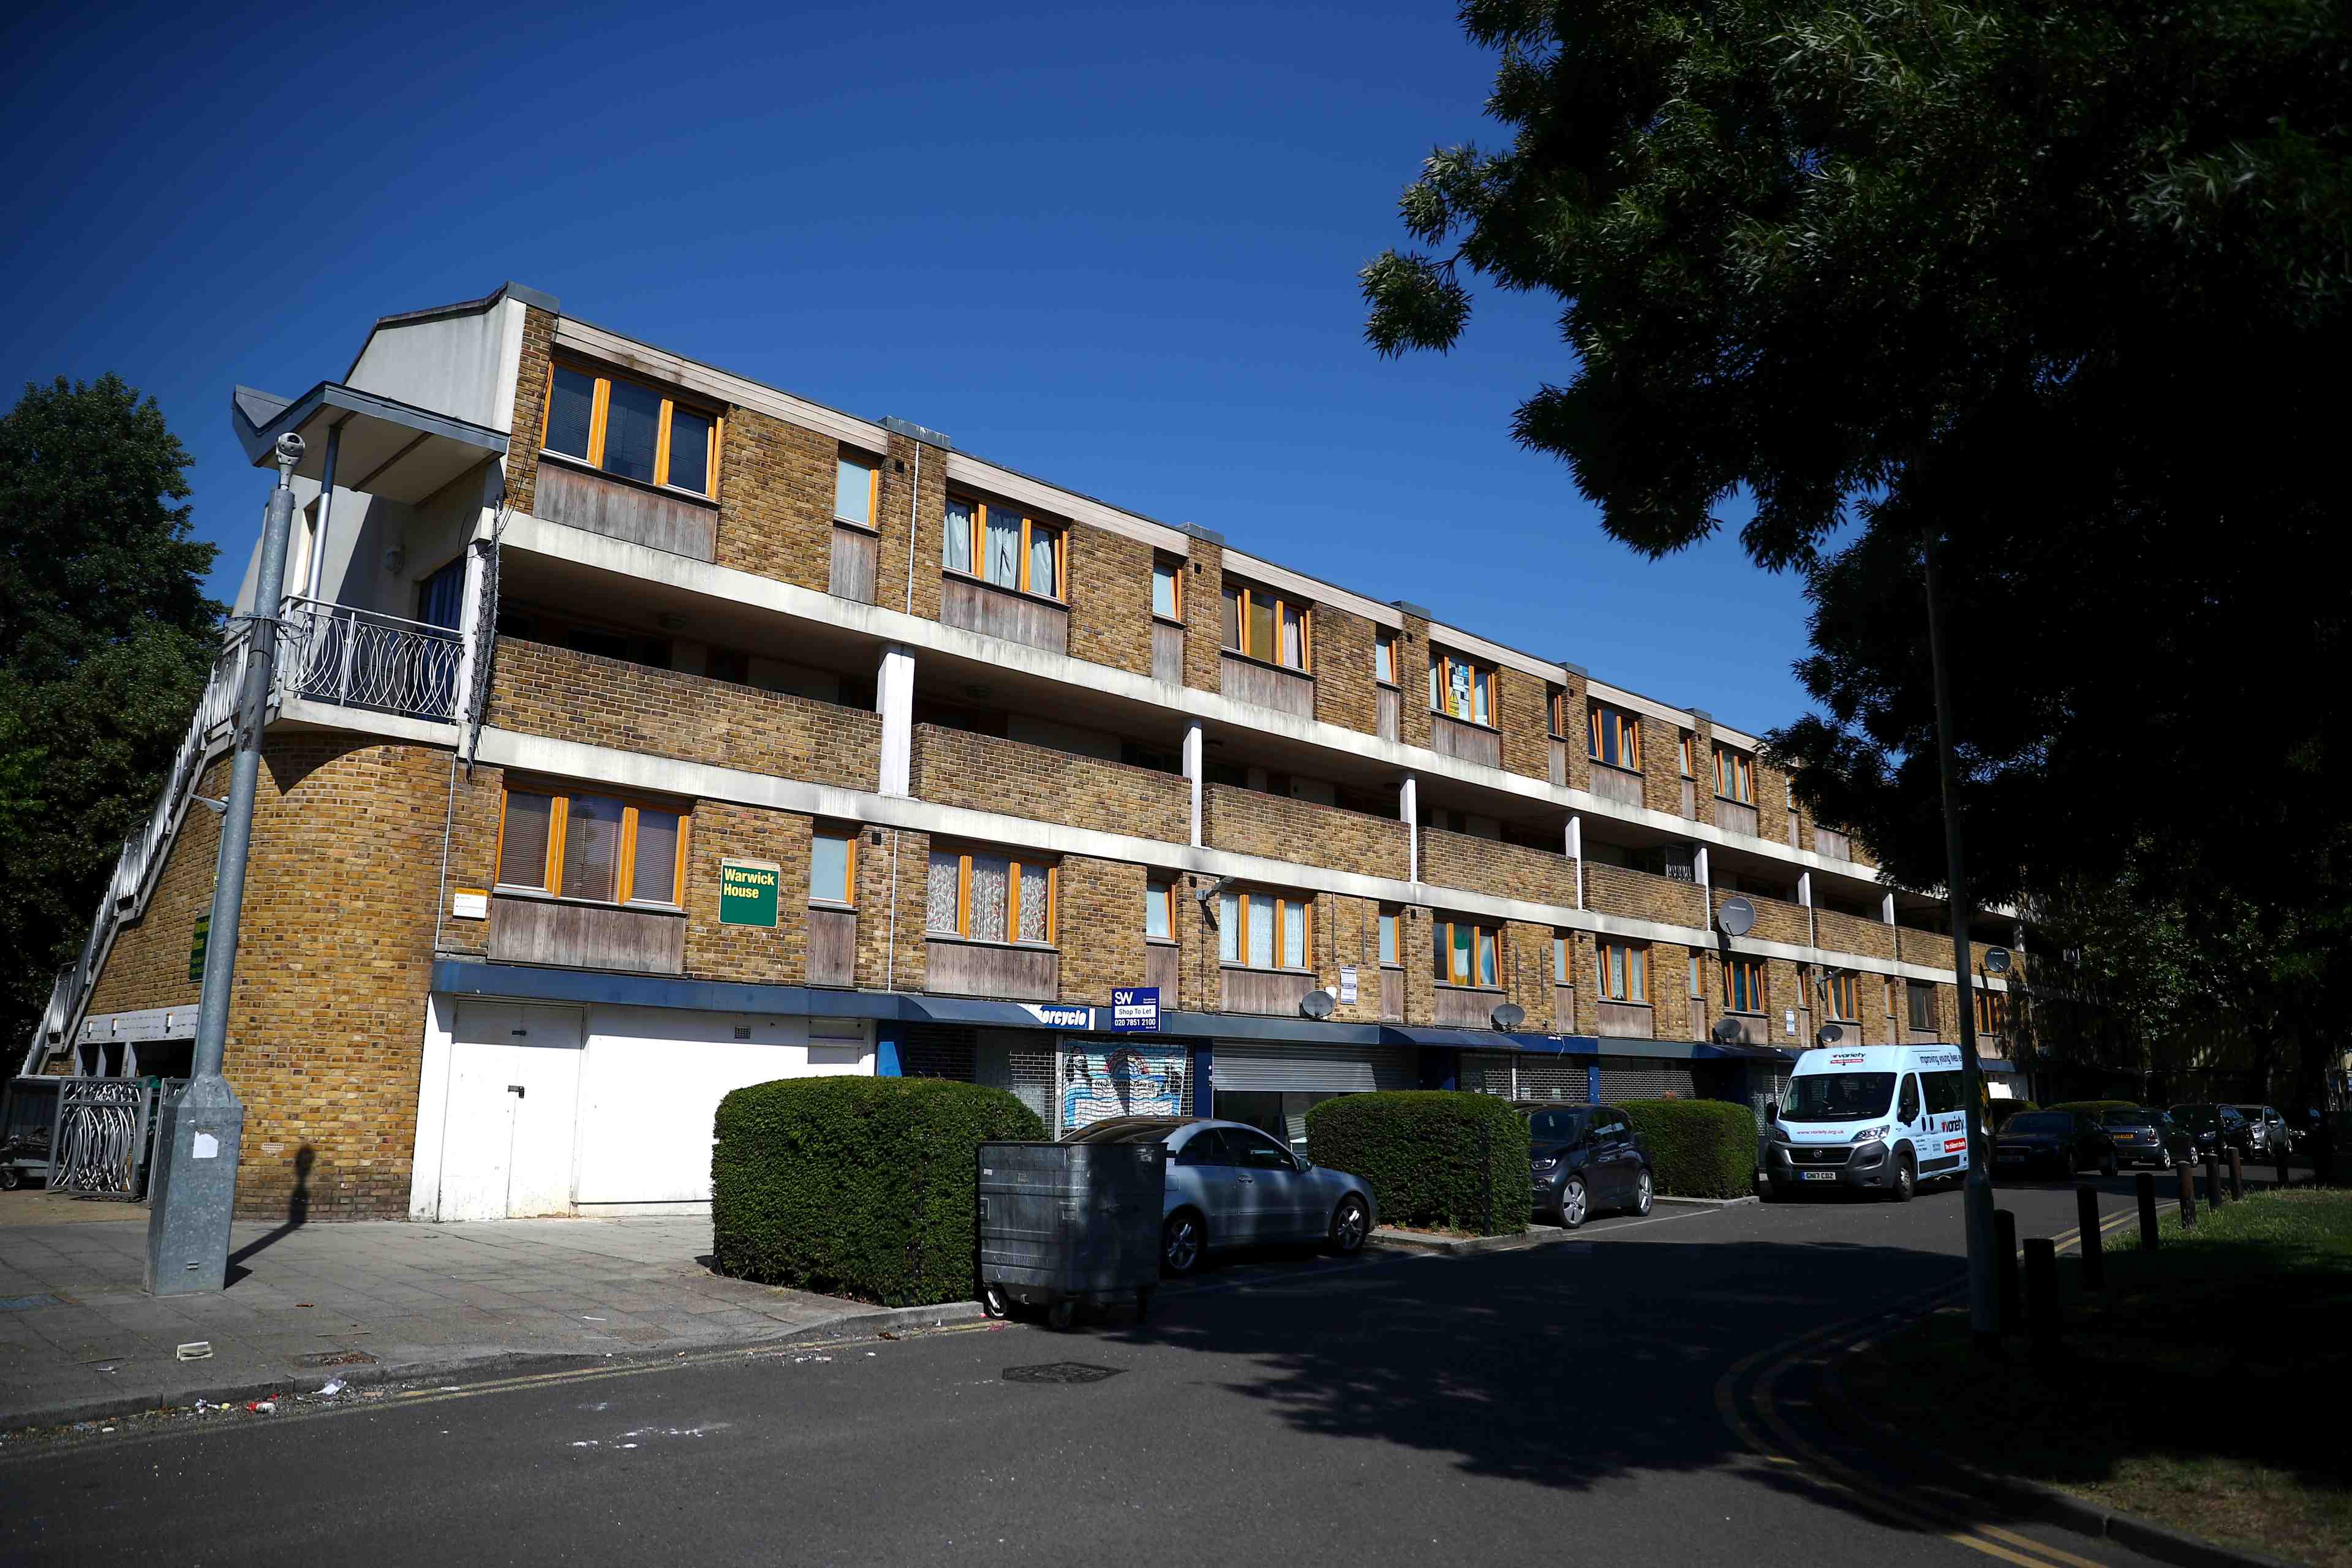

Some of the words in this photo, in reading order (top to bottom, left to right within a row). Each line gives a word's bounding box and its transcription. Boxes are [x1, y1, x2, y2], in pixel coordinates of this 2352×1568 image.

[724, 868, 774, 886] Warwick
[723, 883, 759, 899] House
[1115, 992, 1133, 1005] SW
[1945, 1116, 1964, 1134] variety
